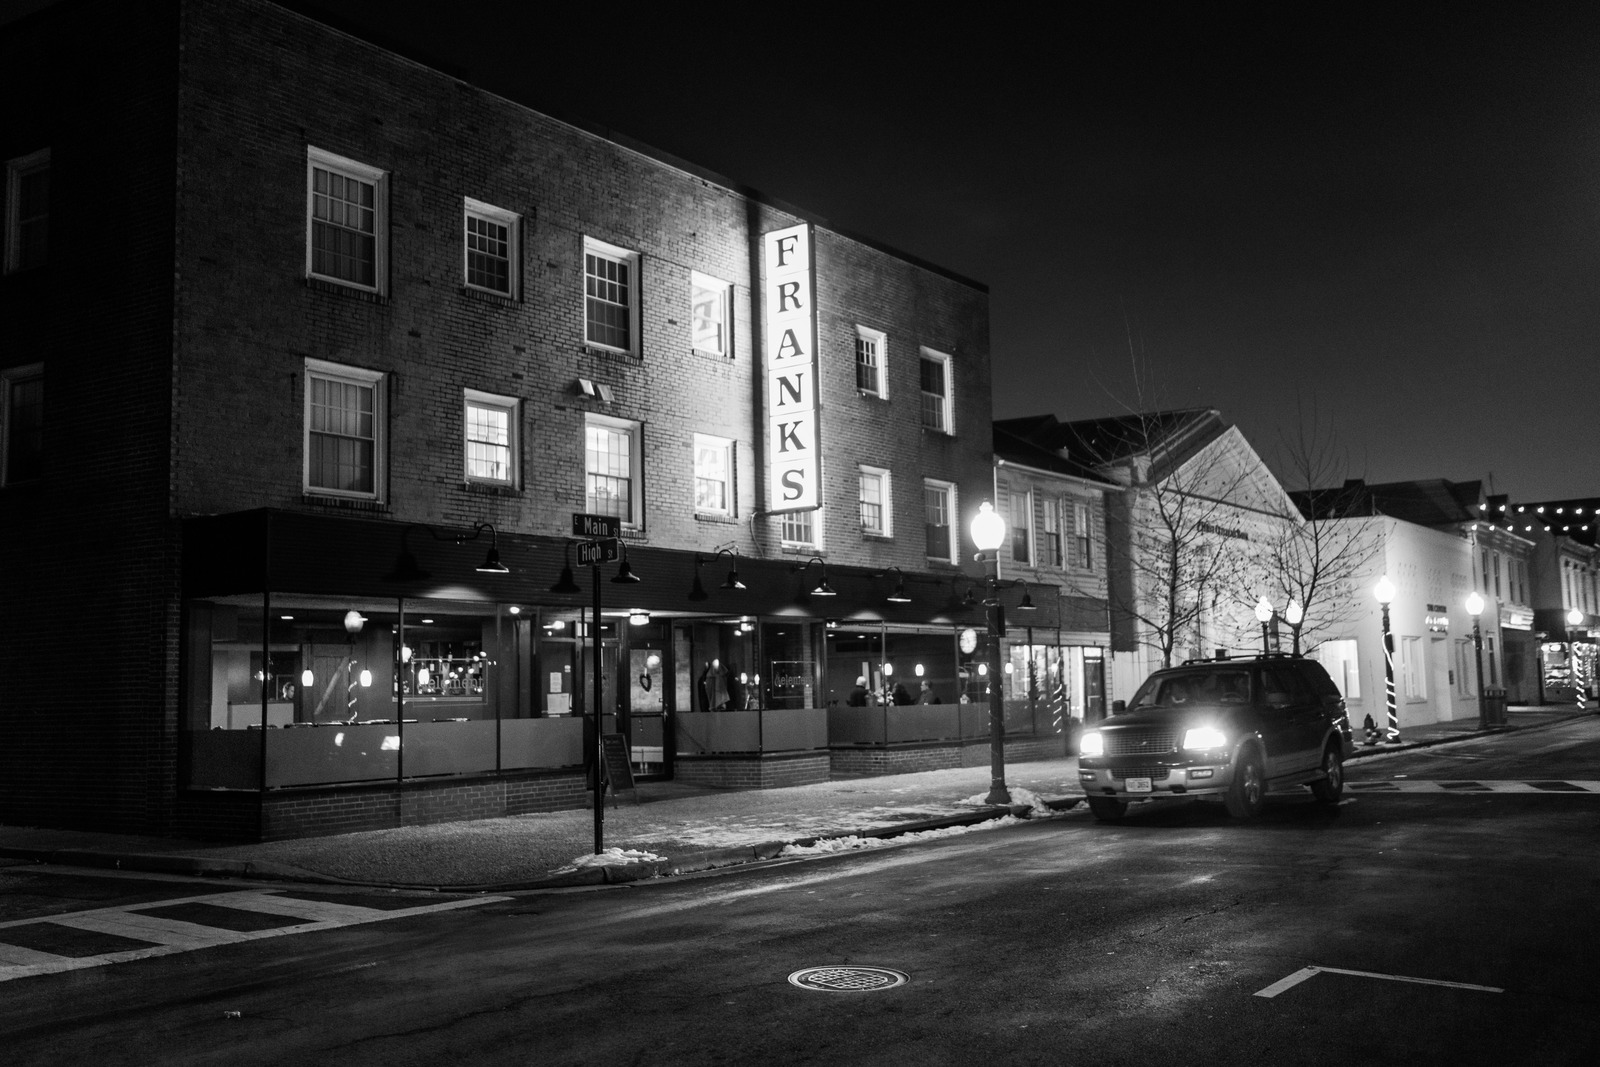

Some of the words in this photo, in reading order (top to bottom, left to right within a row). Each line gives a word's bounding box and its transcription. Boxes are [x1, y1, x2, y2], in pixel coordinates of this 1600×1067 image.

[775, 235, 807, 501] FRANKS
[574, 515, 579, 526] E
[584, 517, 608, 536] Main
[612, 527, 619, 537] St
[582, 543, 602, 563] High
[607, 549, 613, 559] St
[428, 675, 485, 690] element
[780, 673, 815, 687] elemen
